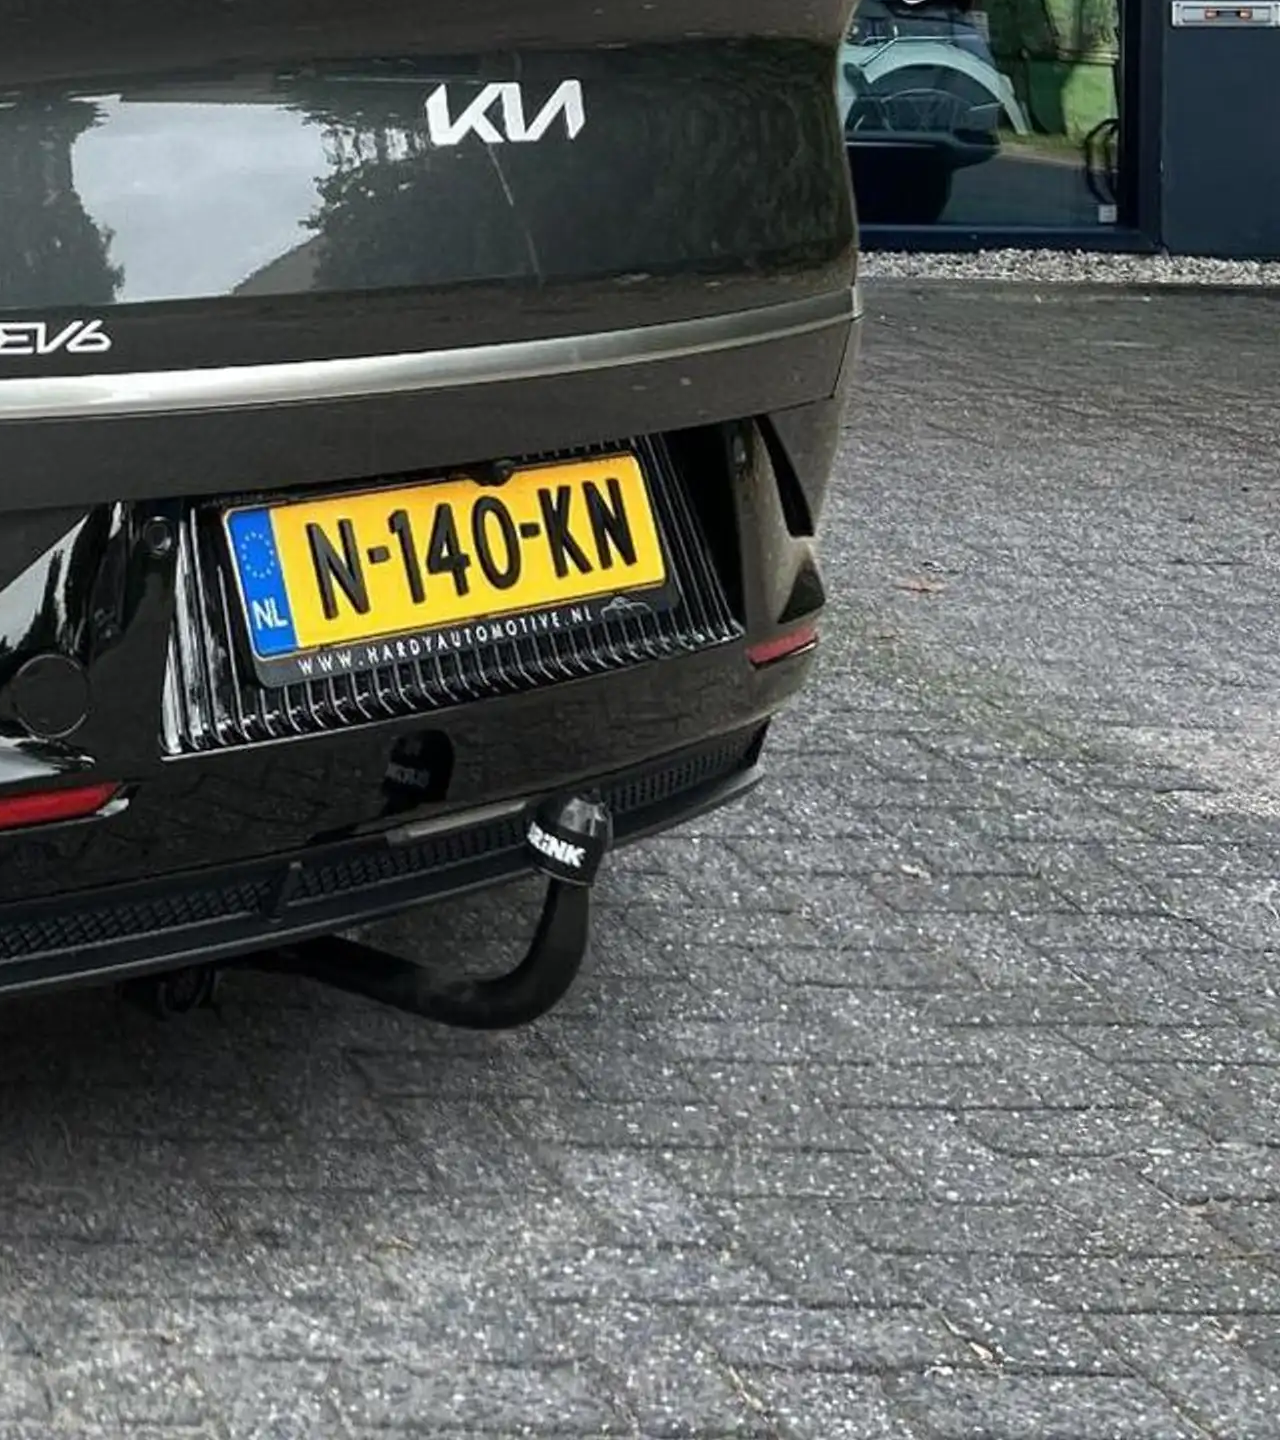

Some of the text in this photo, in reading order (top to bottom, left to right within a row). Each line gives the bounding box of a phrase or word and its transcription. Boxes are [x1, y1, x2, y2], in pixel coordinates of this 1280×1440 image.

[425, 79, 585, 146] KIA
[305, 477, 639, 620] N-140-KN
[251, 597, 288, 631] NL
